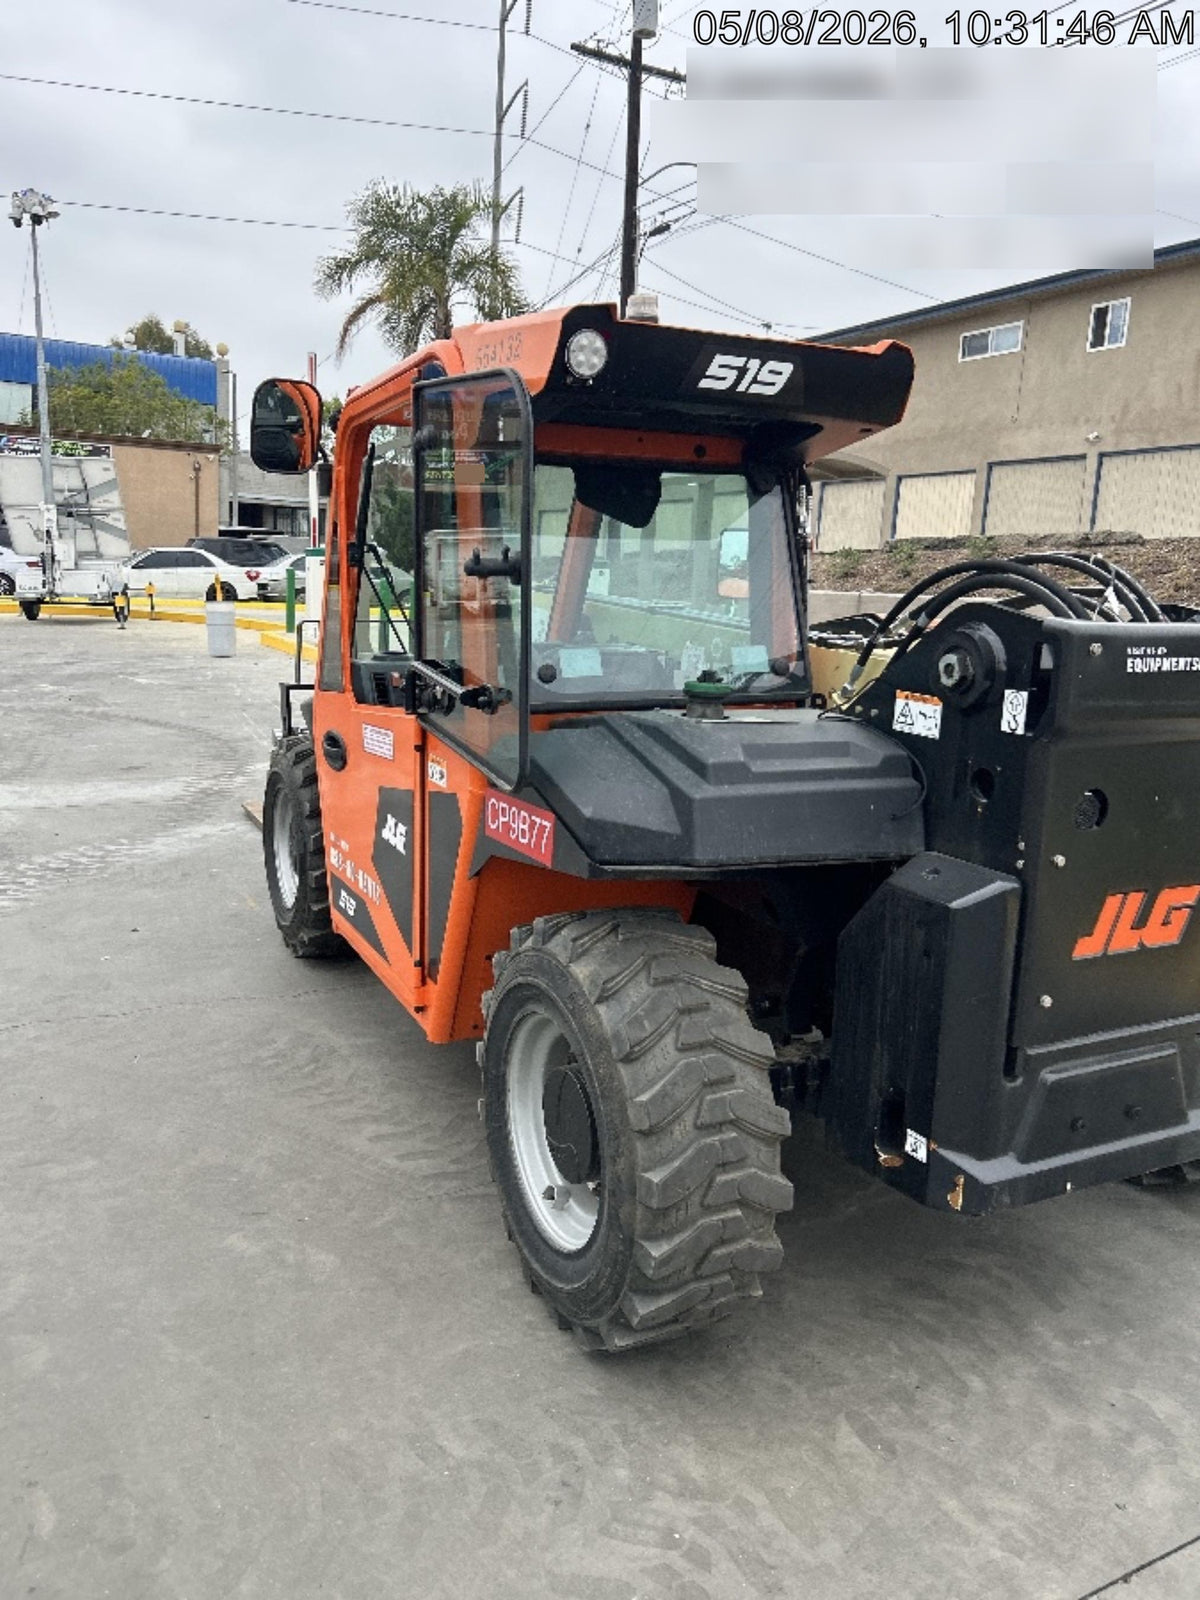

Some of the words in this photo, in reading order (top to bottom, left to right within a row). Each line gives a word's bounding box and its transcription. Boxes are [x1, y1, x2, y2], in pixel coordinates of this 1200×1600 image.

[697, 353, 794, 396] 519
[1126, 657, 1200, 673] EQUIPMENTS
[488, 797, 552, 855] CP9B77
[1071, 884, 1200, 960] JLG
